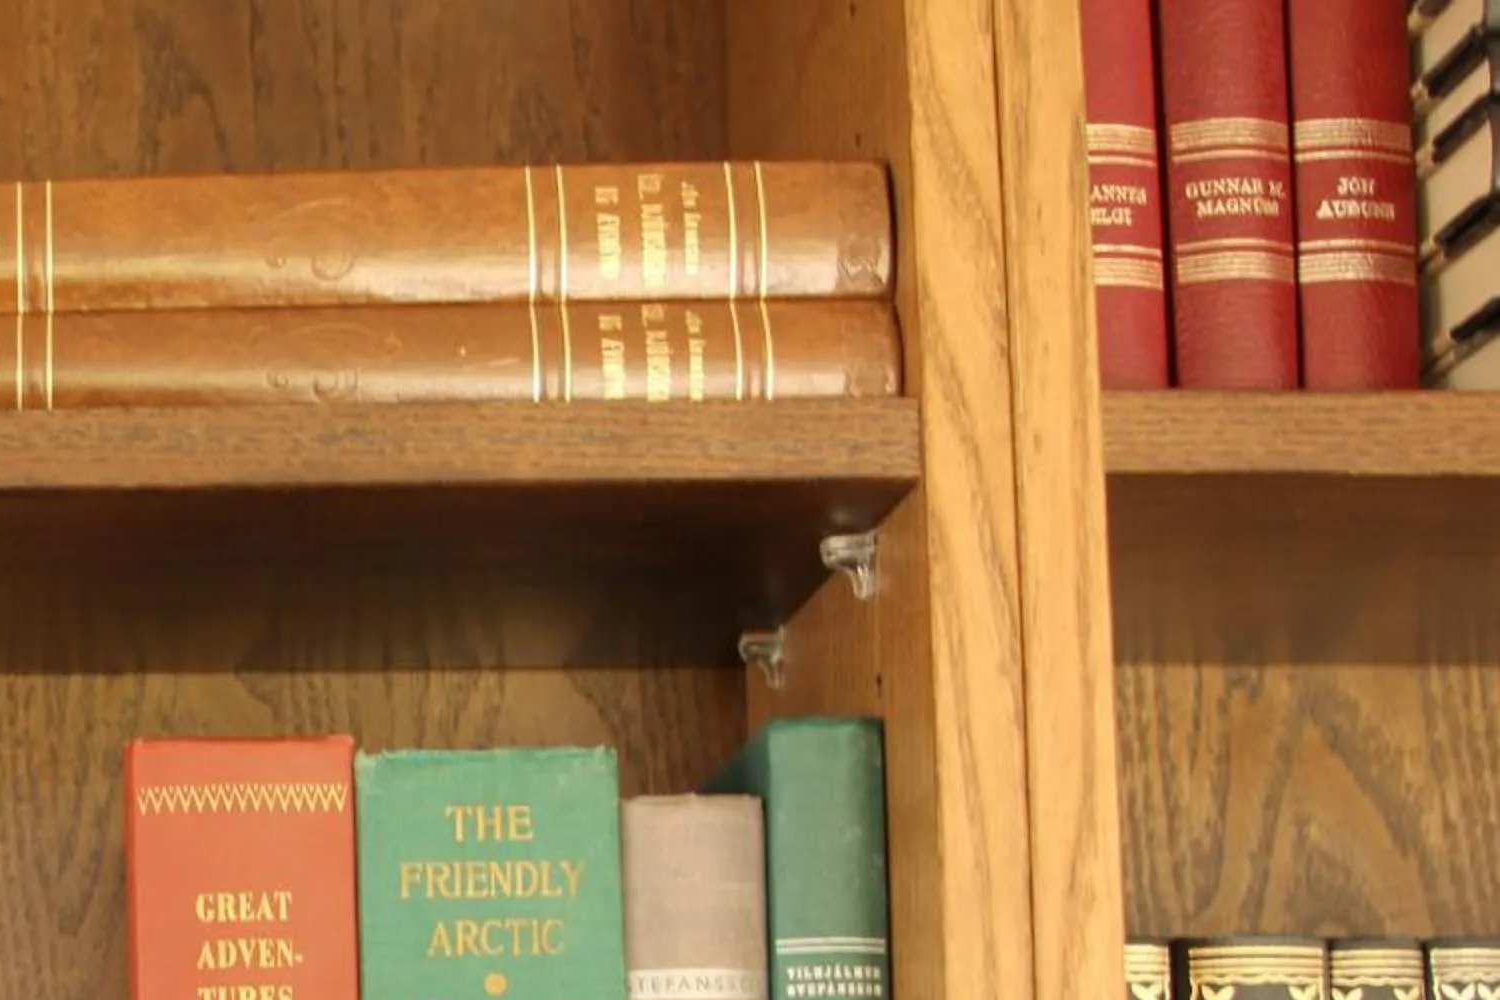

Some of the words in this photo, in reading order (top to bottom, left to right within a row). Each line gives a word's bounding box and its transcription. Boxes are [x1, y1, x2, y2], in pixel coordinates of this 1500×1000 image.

[1090, 184, 1147, 206] ANNES
[1185, 177, 1263, 199] GUNNAR
[446, 804, 533, 842] THE
[400, 861, 585, 899] FRIENDLY
[196, 891, 292, 922] GREAT
[427, 919, 566, 957] ARCTIC
[196, 939, 304, 969] ADVEN-
